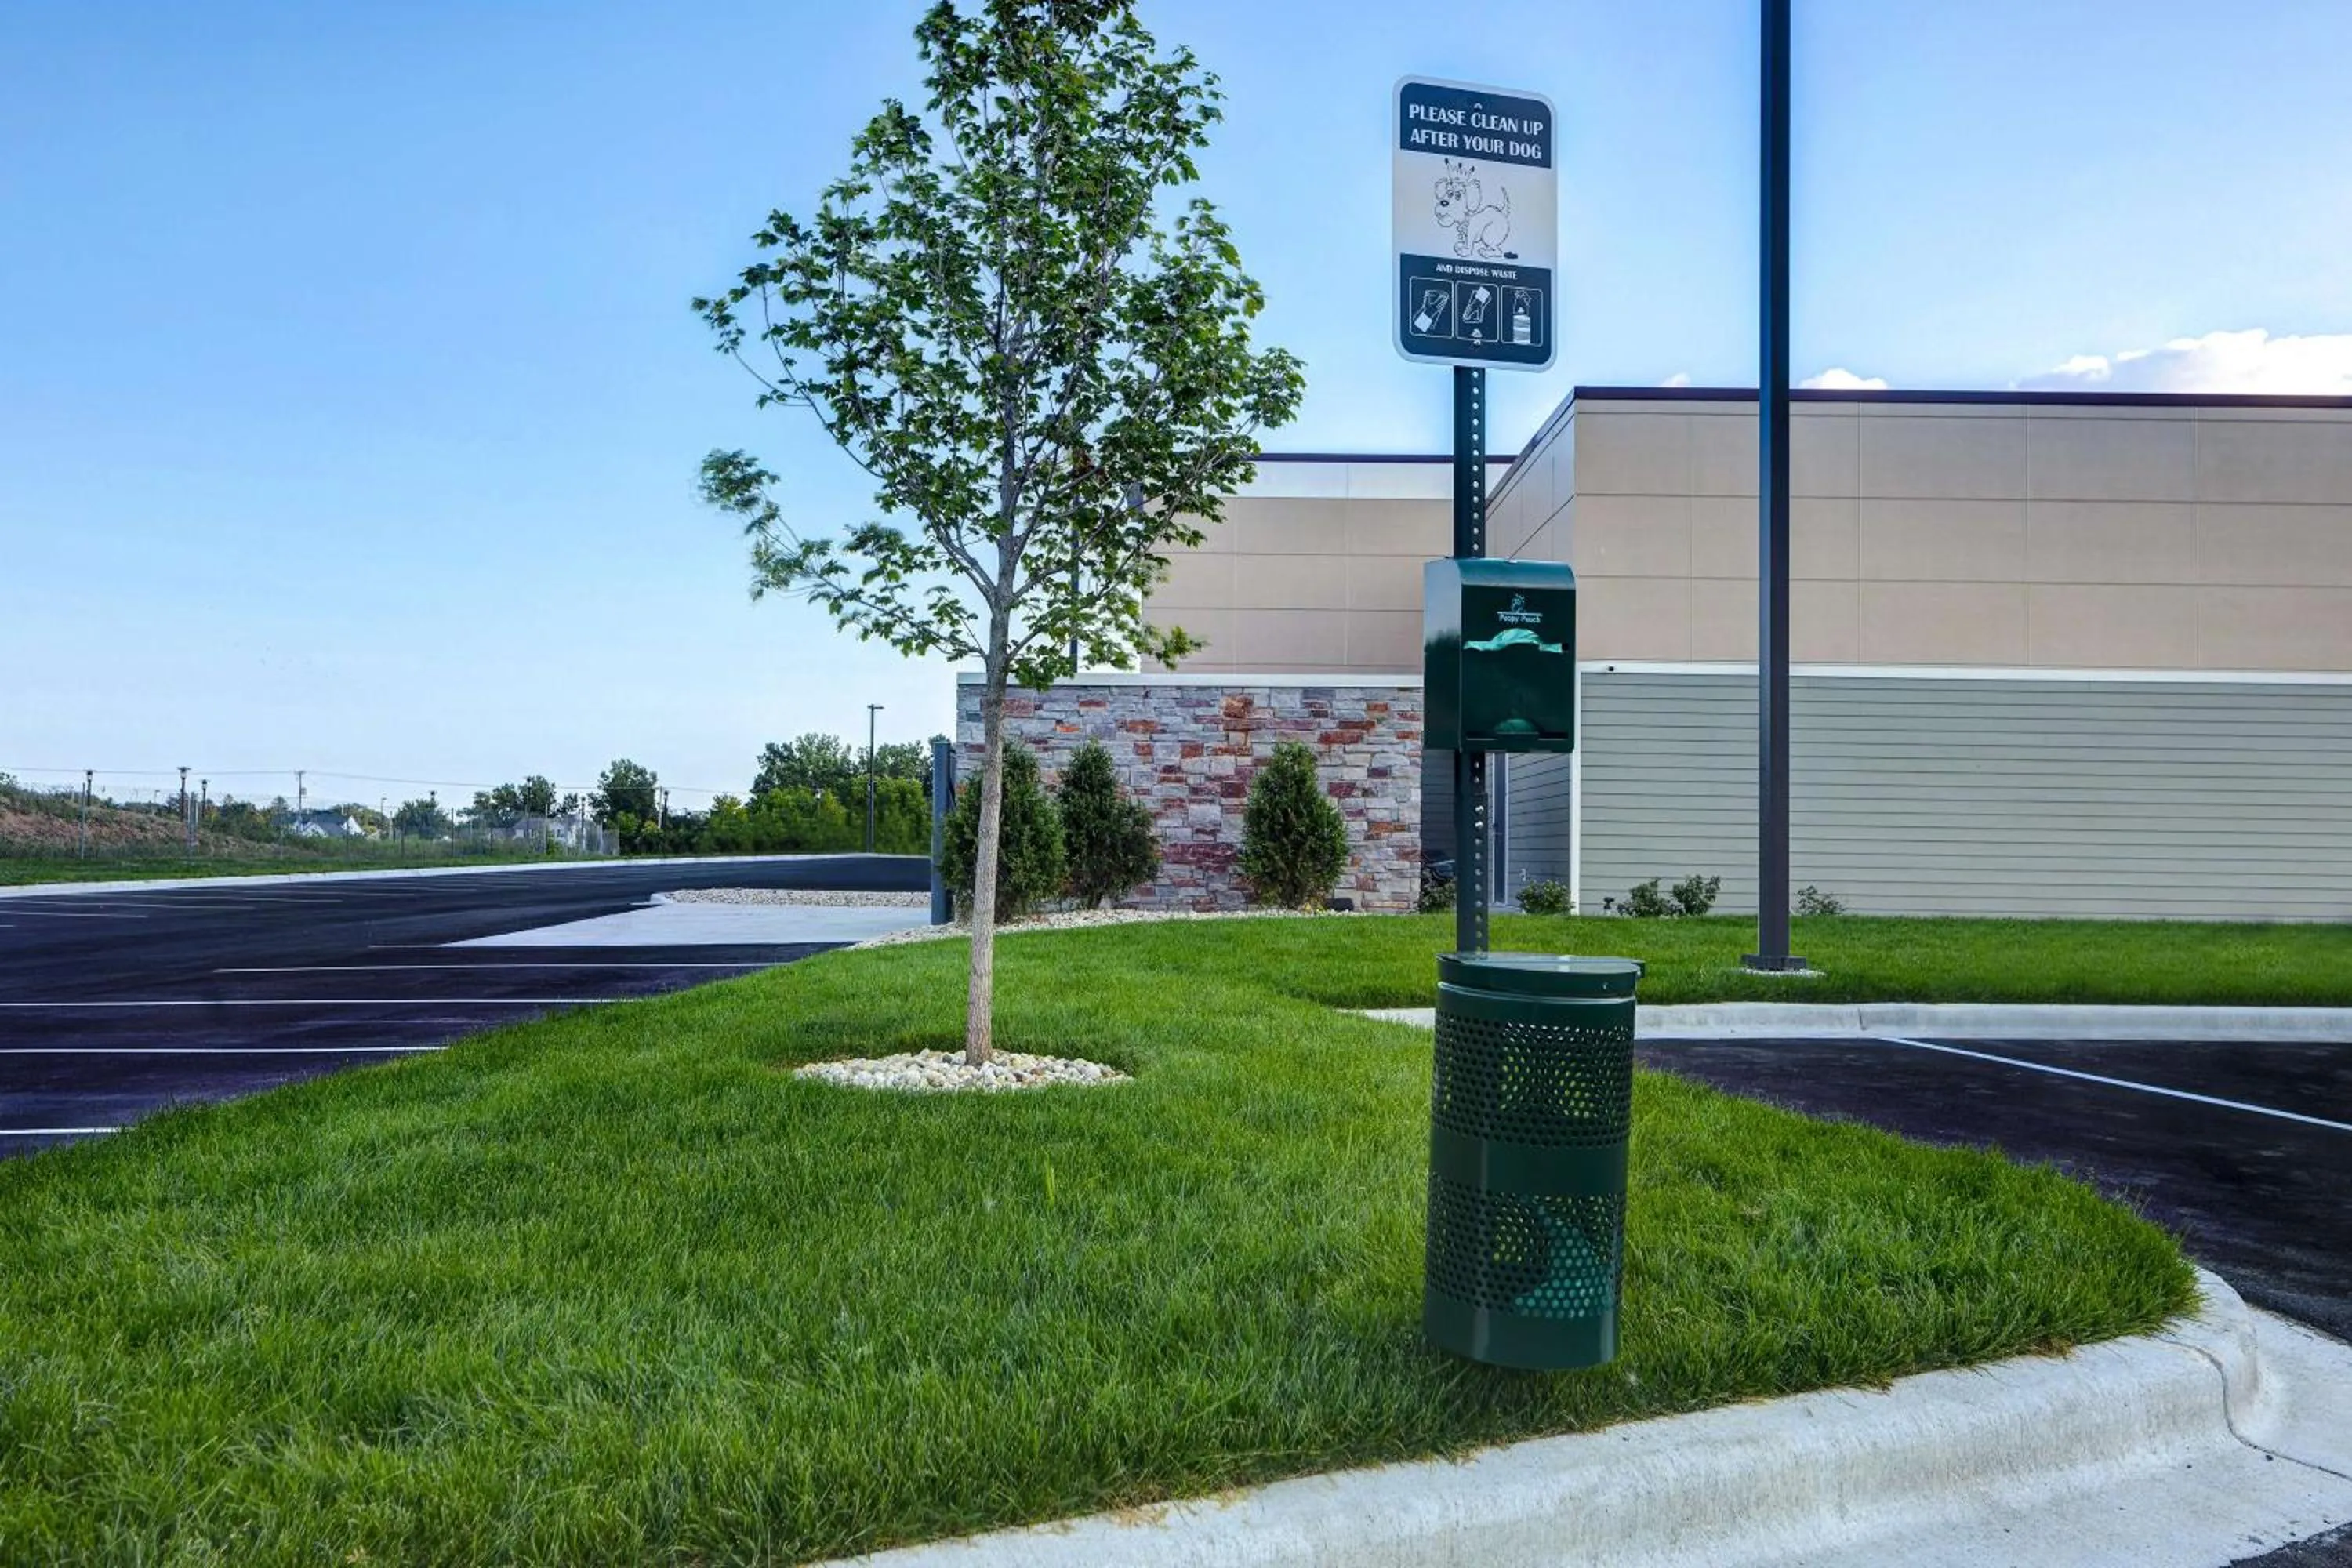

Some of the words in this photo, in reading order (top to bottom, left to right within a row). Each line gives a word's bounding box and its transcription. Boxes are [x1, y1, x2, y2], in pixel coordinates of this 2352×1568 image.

[1409, 103, 1466, 126] PLEASE
[1471, 112, 1518, 133] CLEAN
[1523, 120, 1544, 136] UP
[1410, 129, 1458, 148] AFTER
[1463, 134, 1504, 154] YOUR
[1509, 140, 1542, 159] DOG
[1436, 263, 1453, 274] AND
[1454, 264, 1489, 276] DISPOSE
[1490, 269, 1518, 280] WASTE
